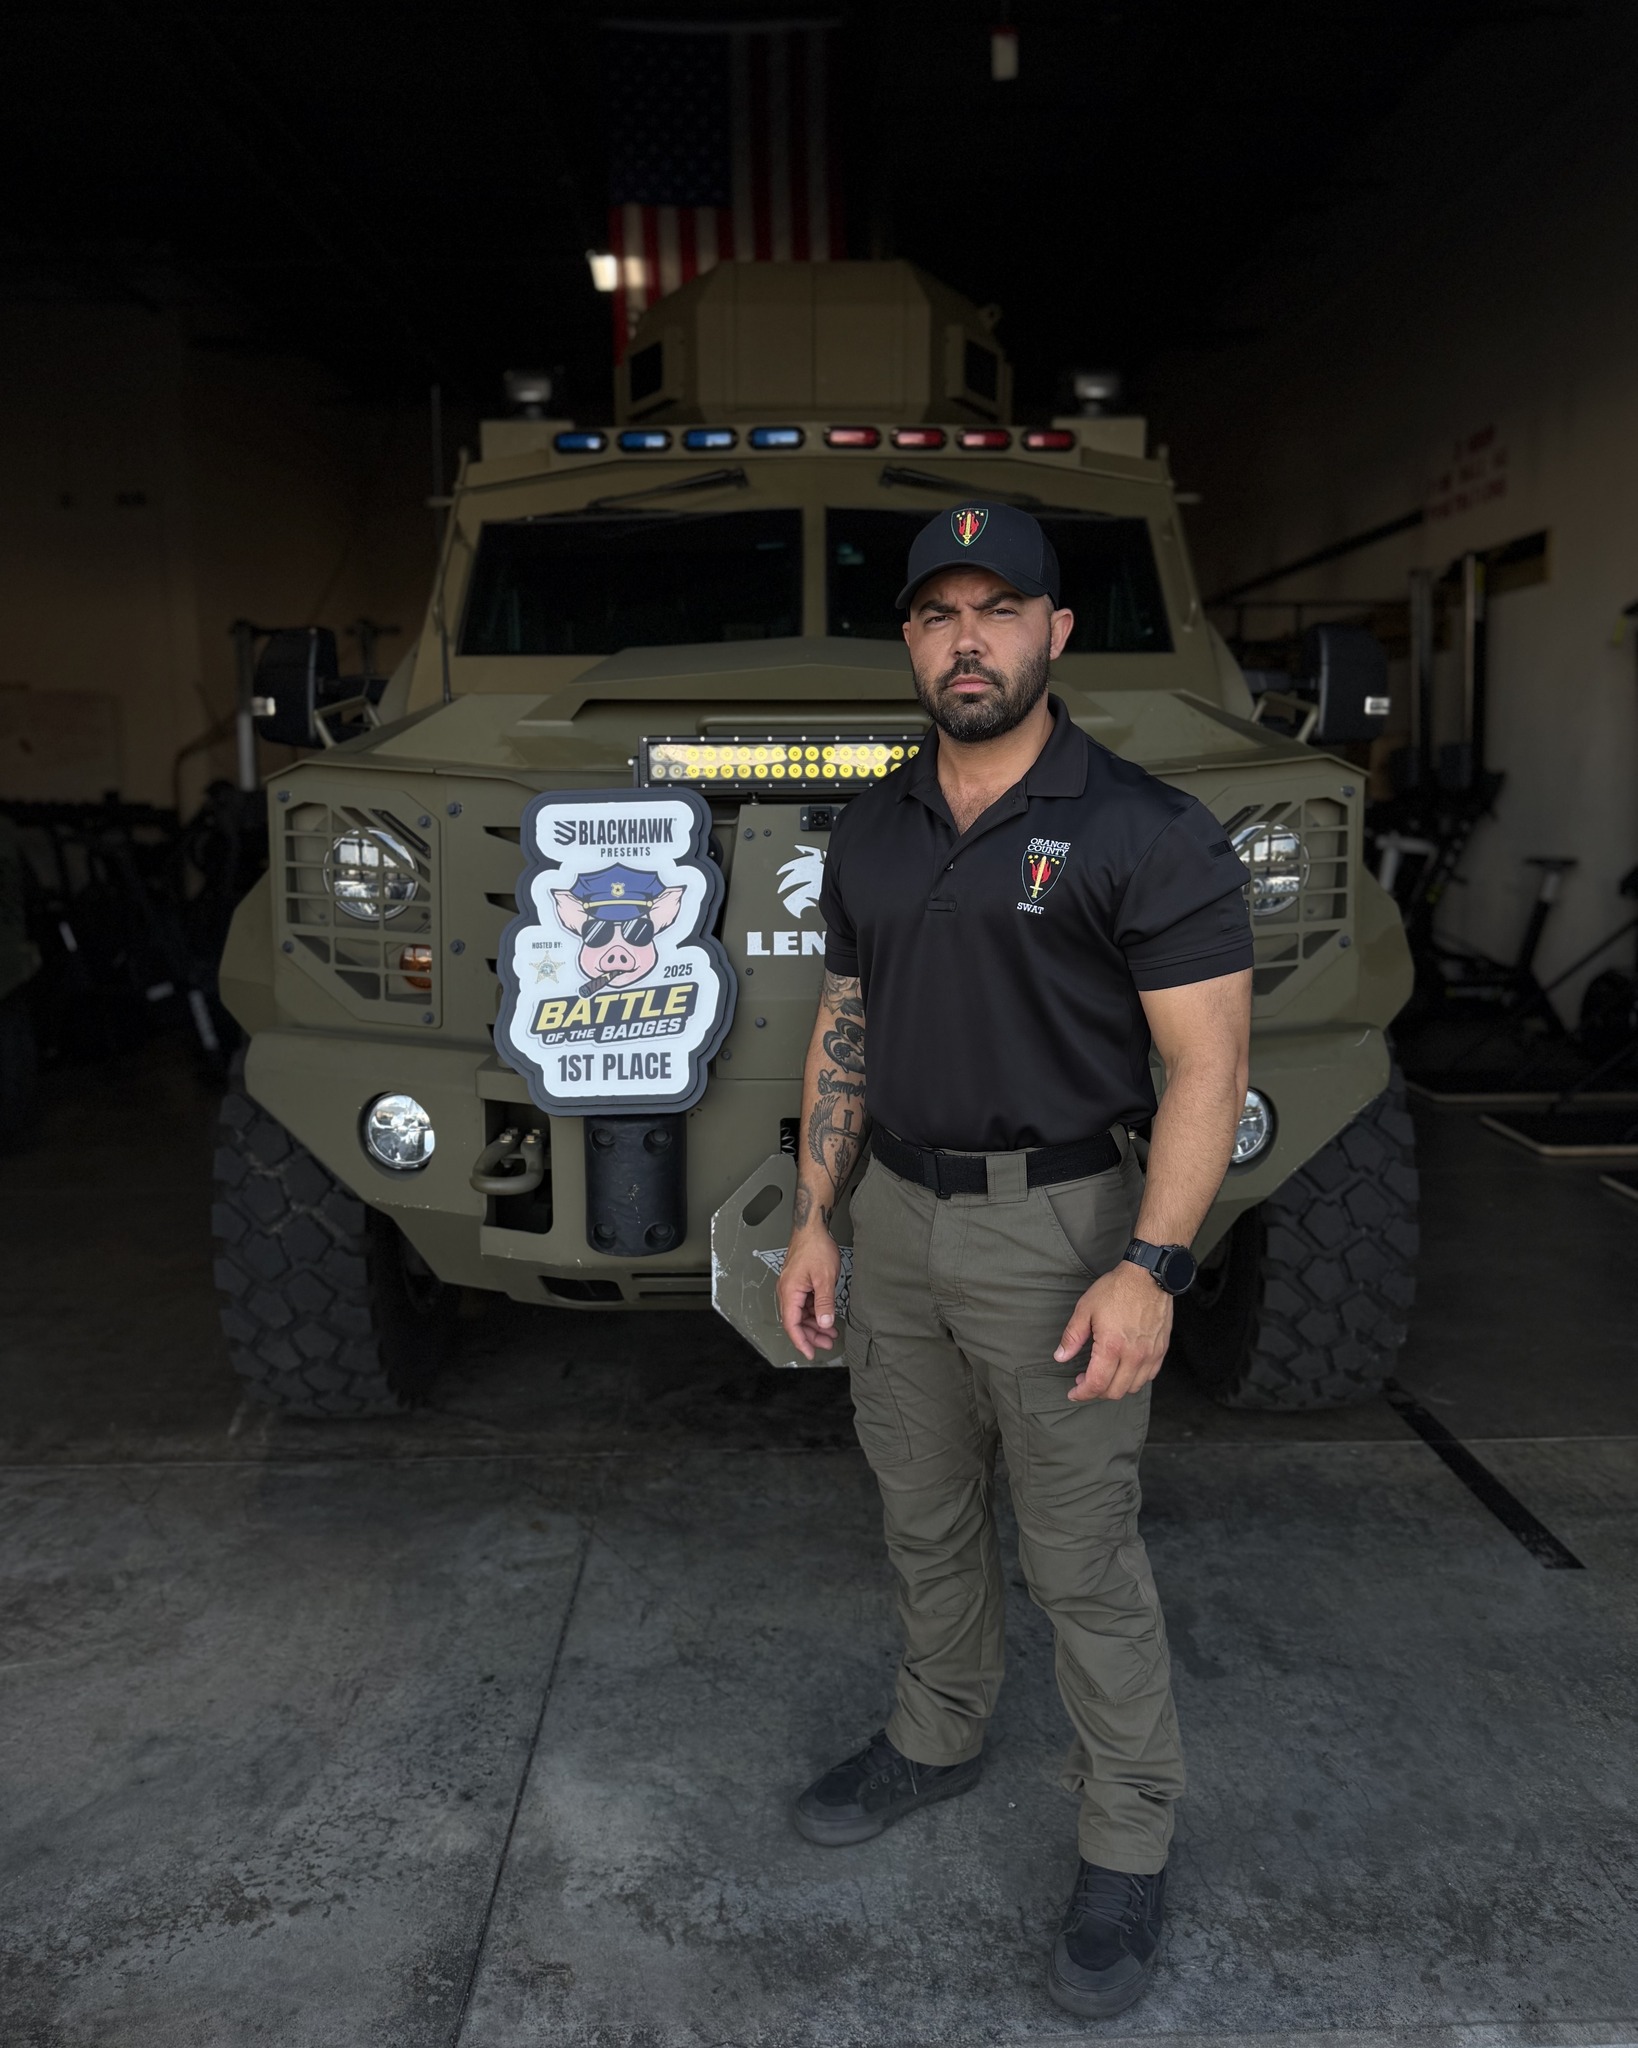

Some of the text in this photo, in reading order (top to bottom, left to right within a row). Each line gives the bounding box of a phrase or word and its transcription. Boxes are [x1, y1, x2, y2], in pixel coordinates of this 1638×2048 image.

[579, 818, 673, 845] BLACKHAWK
[1027, 844, 1069, 857] COUNTY
[1030, 838, 1071, 850] ORANGE
[600, 847, 651, 858] PRESENTS
[1016, 902, 1045, 915] SWAT
[554, 941, 563, 949] BY:
[664, 963, 693, 978] 2025
[536, 985, 693, 1031] BATTLE
[545, 1018, 682, 1043] OF THE BADGES
[558, 1052, 672, 1082] 1ST PLACE
